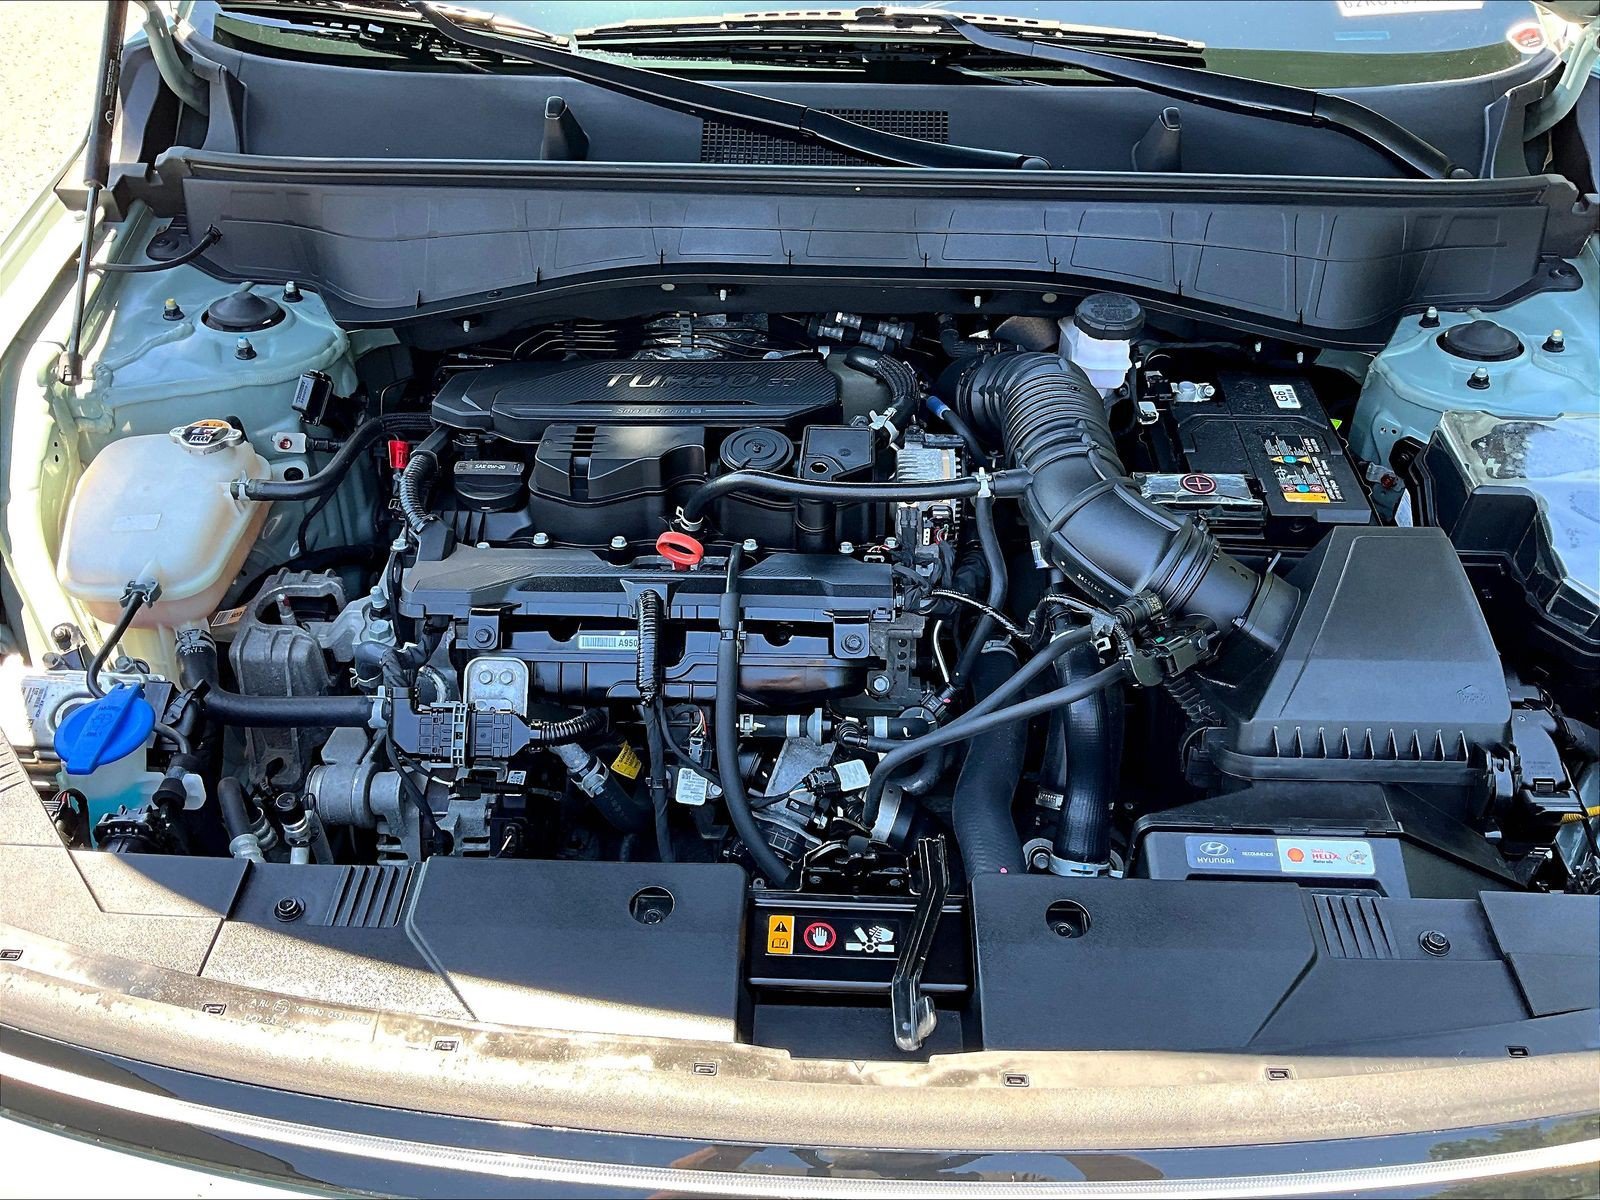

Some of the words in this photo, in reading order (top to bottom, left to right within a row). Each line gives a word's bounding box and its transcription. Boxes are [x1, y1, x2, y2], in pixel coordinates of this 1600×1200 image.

[605, 372, 760, 389] TURBO
[1275, 390, 1288, 402] G6
[618, 638, 638, 648] A950
[1196, 856, 1235, 865] HYUNDAI
